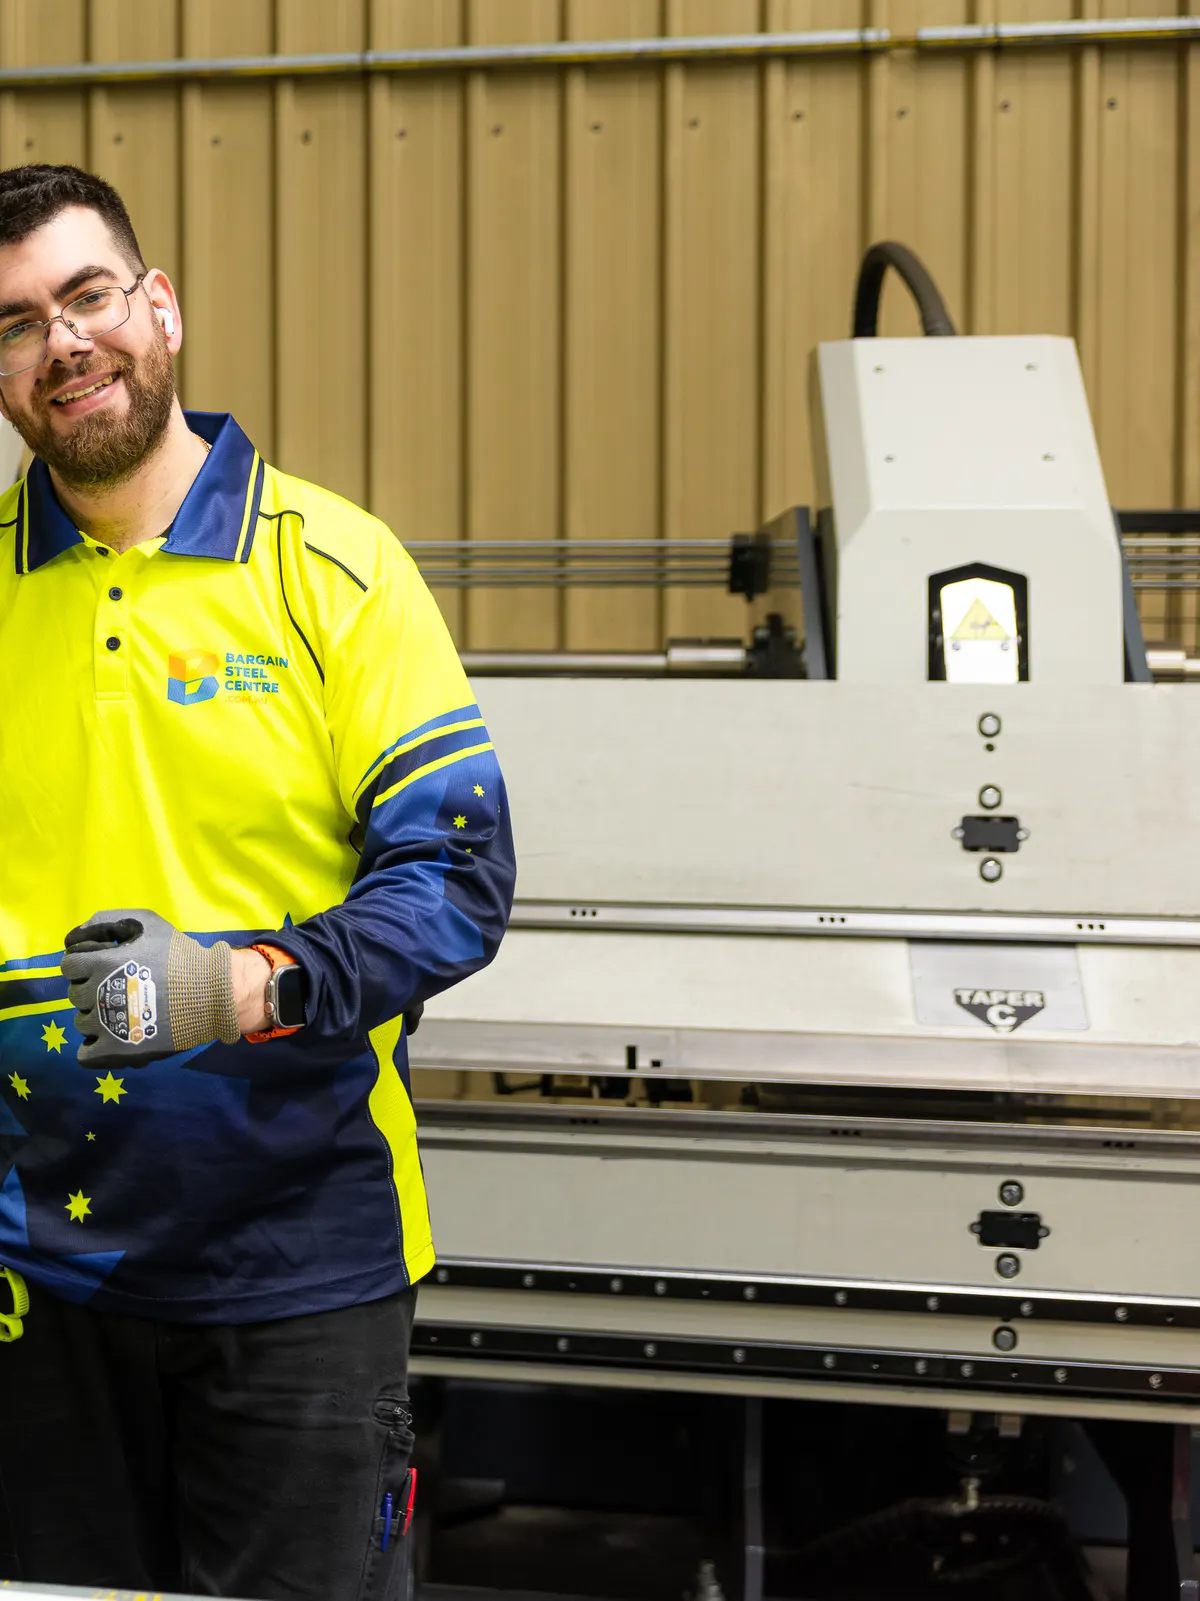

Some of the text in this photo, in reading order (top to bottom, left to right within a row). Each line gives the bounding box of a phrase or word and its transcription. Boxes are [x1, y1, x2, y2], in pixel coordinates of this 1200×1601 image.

[226, 653, 288, 668] BARGAIN
[225, 666, 267, 678] STEEL
[225, 680, 278, 693] CENTRE
[955, 988, 1044, 1007] TAPER
[986, 1004, 1018, 1026] C
